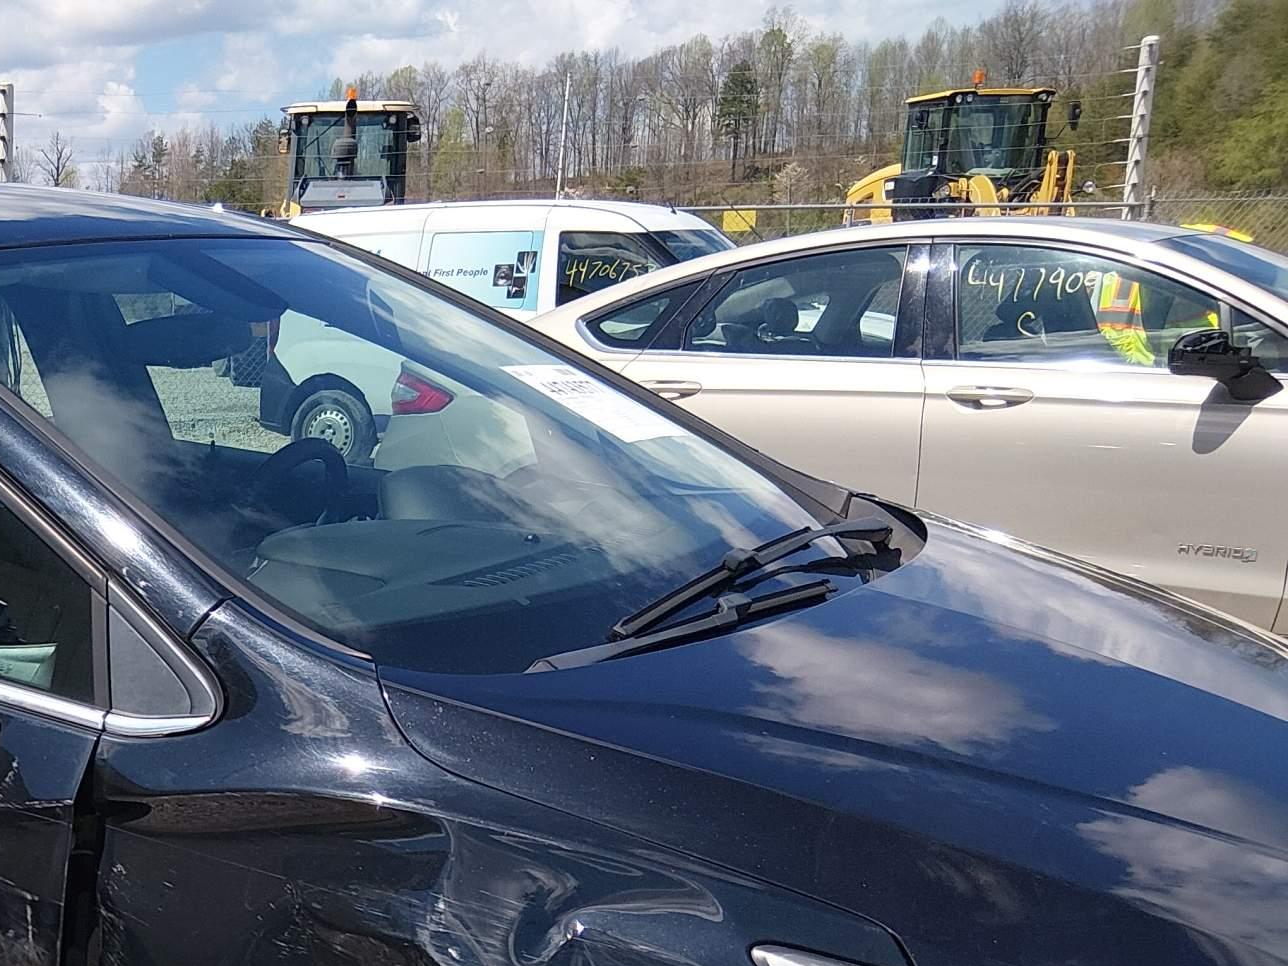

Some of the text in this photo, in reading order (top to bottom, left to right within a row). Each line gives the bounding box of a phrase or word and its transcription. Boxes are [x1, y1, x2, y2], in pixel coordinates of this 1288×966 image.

[433, 268, 455, 278] First
[456, 267, 489, 279] People
[1177, 543, 1244, 559] HYBRID
